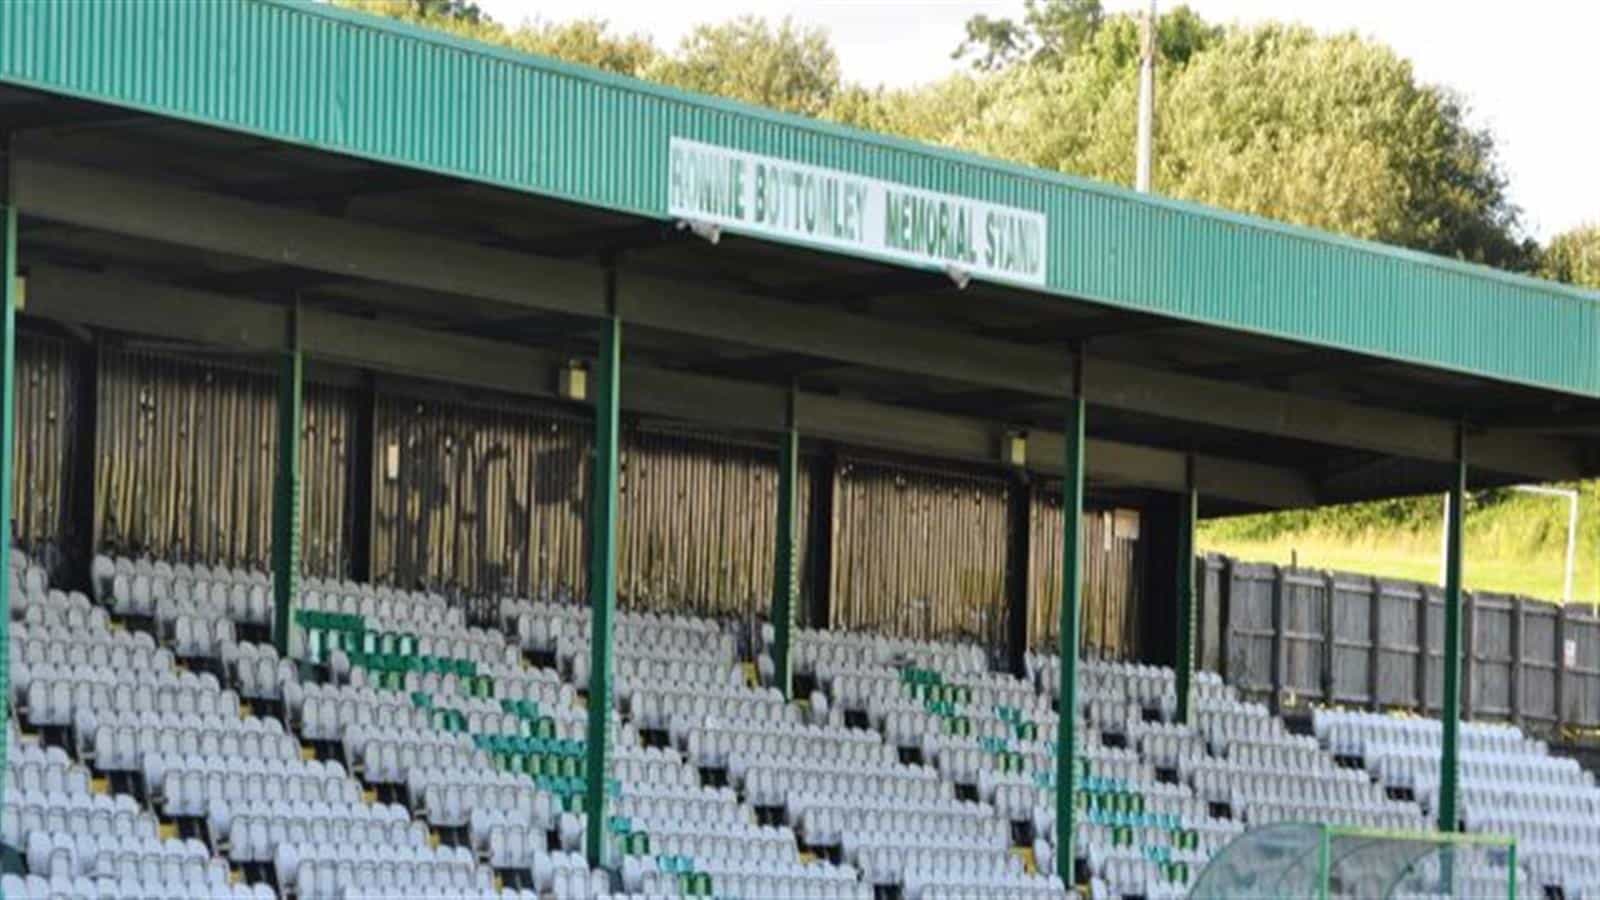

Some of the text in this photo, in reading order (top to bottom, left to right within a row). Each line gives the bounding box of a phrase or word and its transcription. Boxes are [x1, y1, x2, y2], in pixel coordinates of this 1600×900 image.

[671, 146, 1041, 276] RONNIE BOTTOMLEY MEMORIAL STAND
